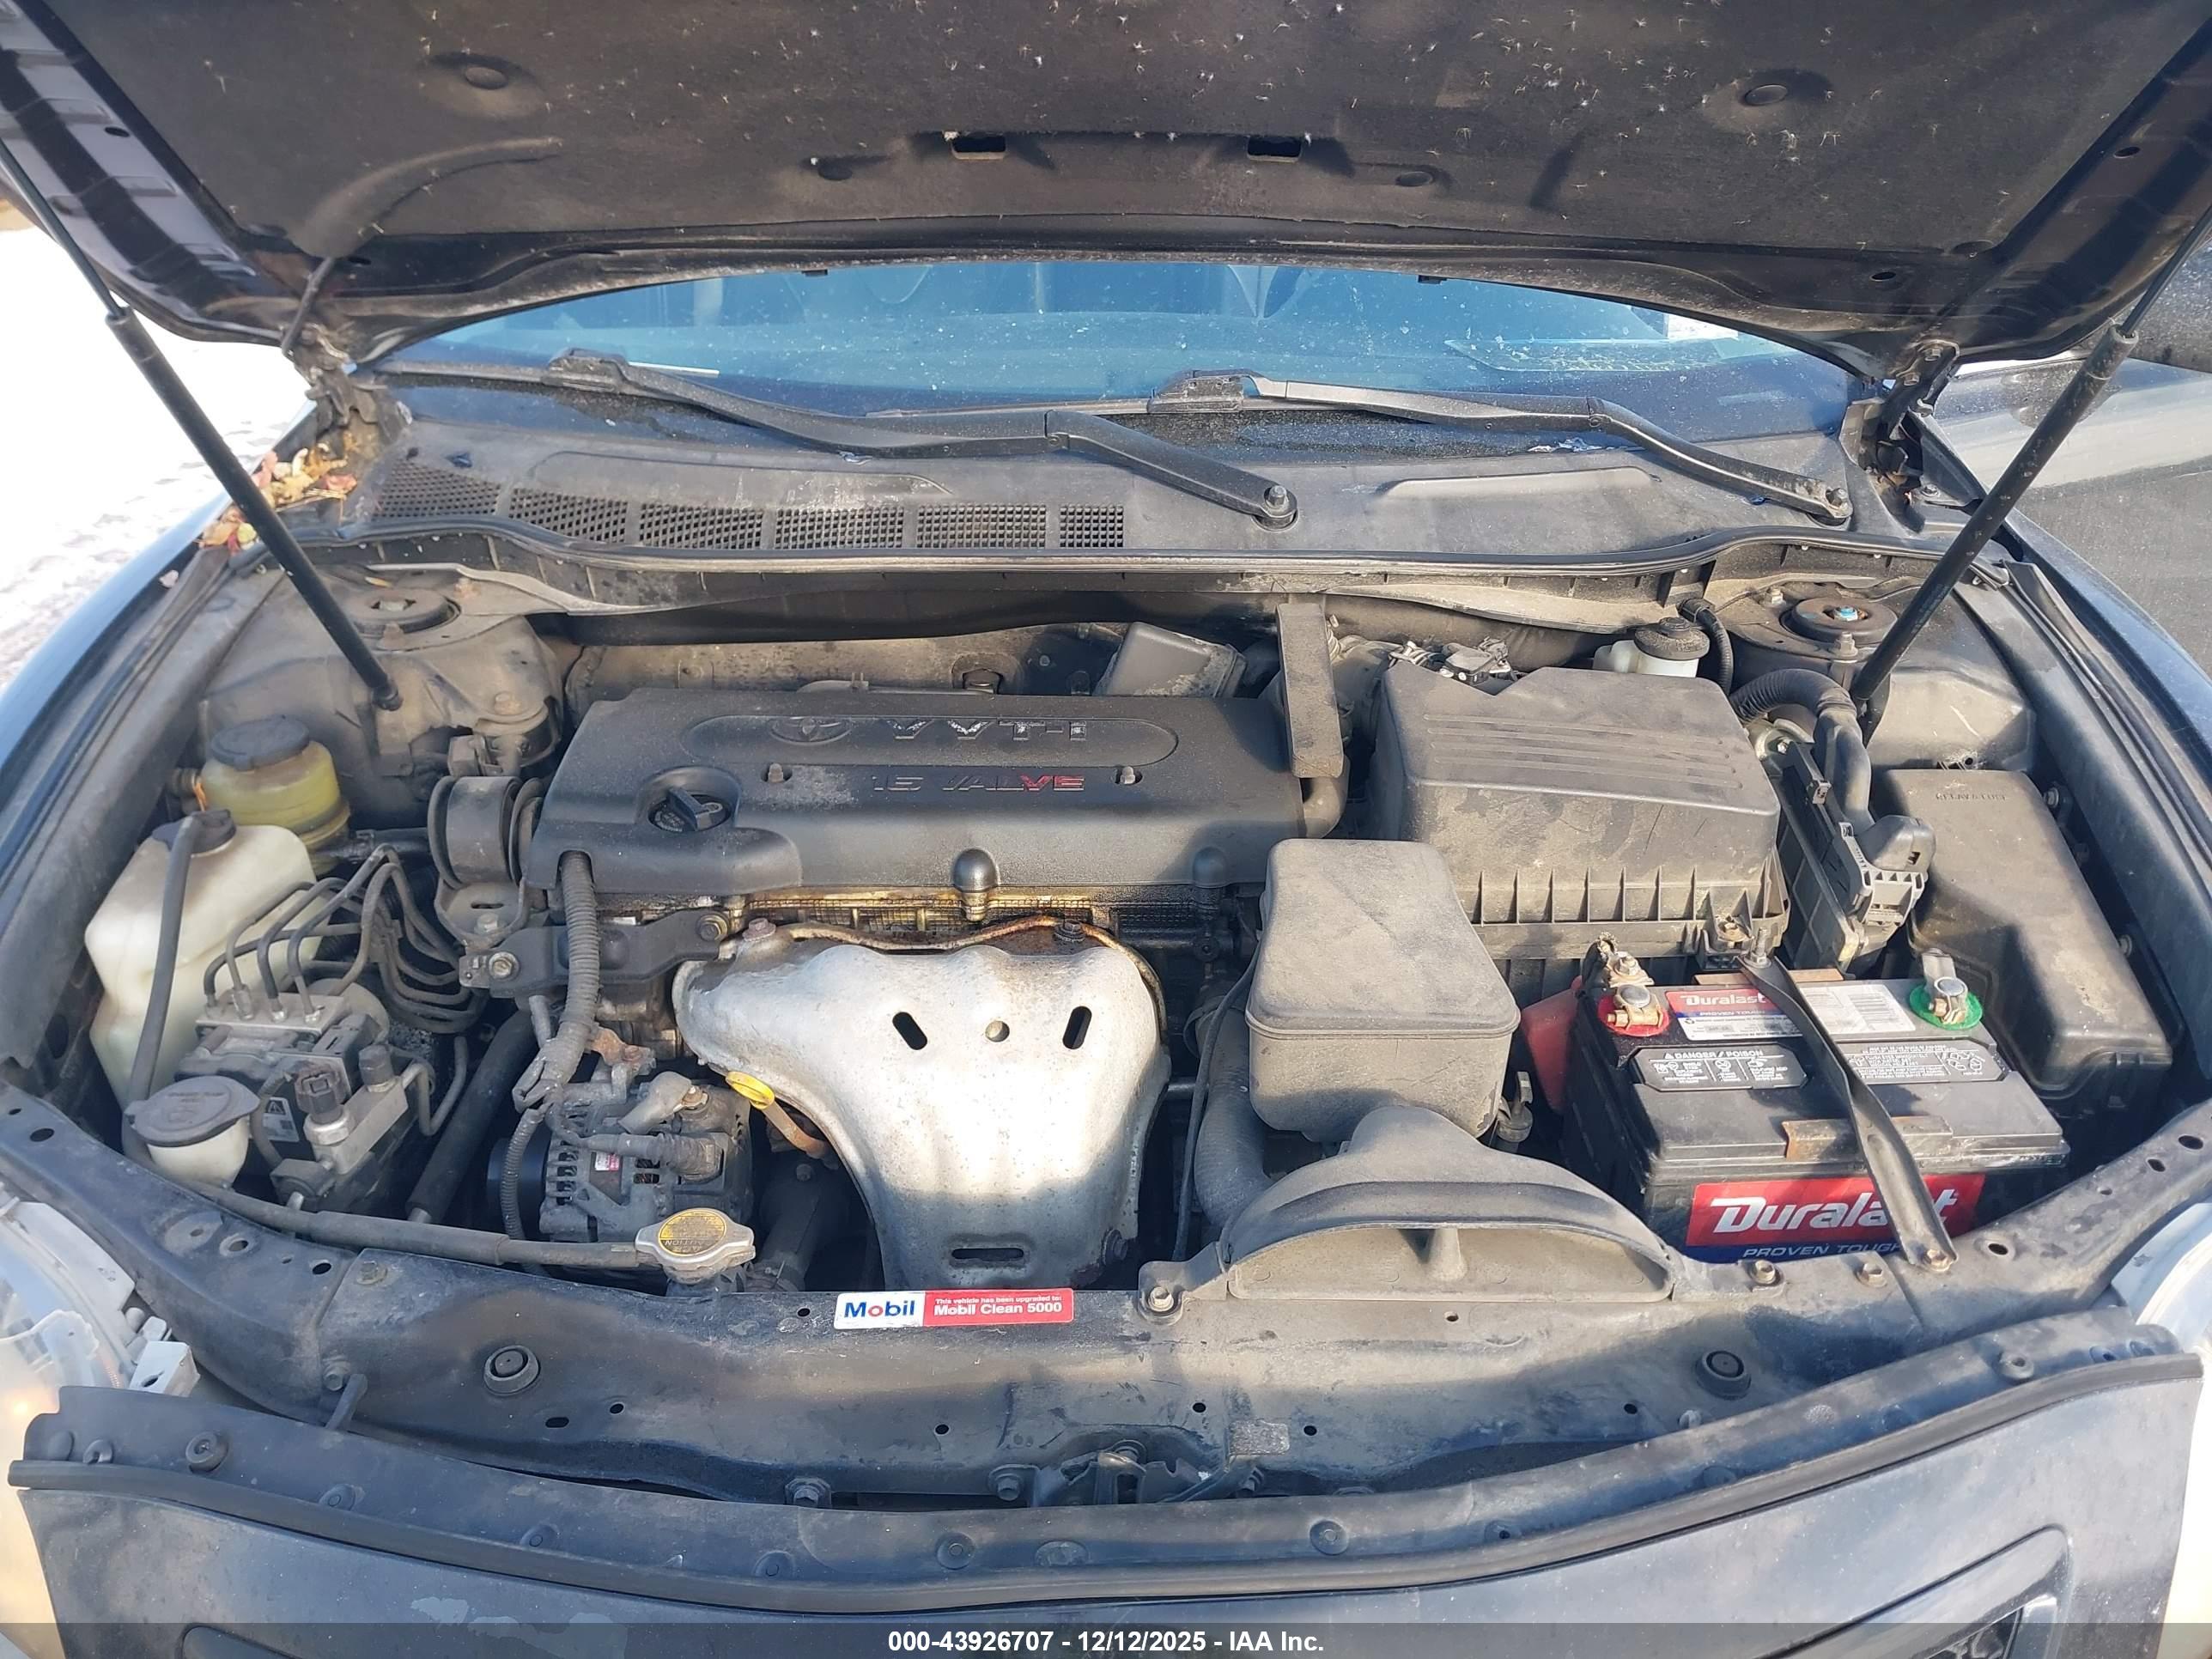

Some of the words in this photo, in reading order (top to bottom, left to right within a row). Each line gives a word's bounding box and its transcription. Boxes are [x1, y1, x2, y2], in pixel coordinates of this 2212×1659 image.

[1680, 993, 1765, 1006] Duralast
[1725, 1049, 1764, 1058] POISON
[1711, 1188, 1959, 1234] Duralat
[1742, 1244, 1830, 1257] PROVEN
[1016, 1295, 1050, 1304] upgraded
[844, 1300, 915, 1318] Mobil
[934, 1304, 976, 1316] Mobil
[981, 1304, 1023, 1315] Clean
[1027, 1303, 1062, 1314] 5000
